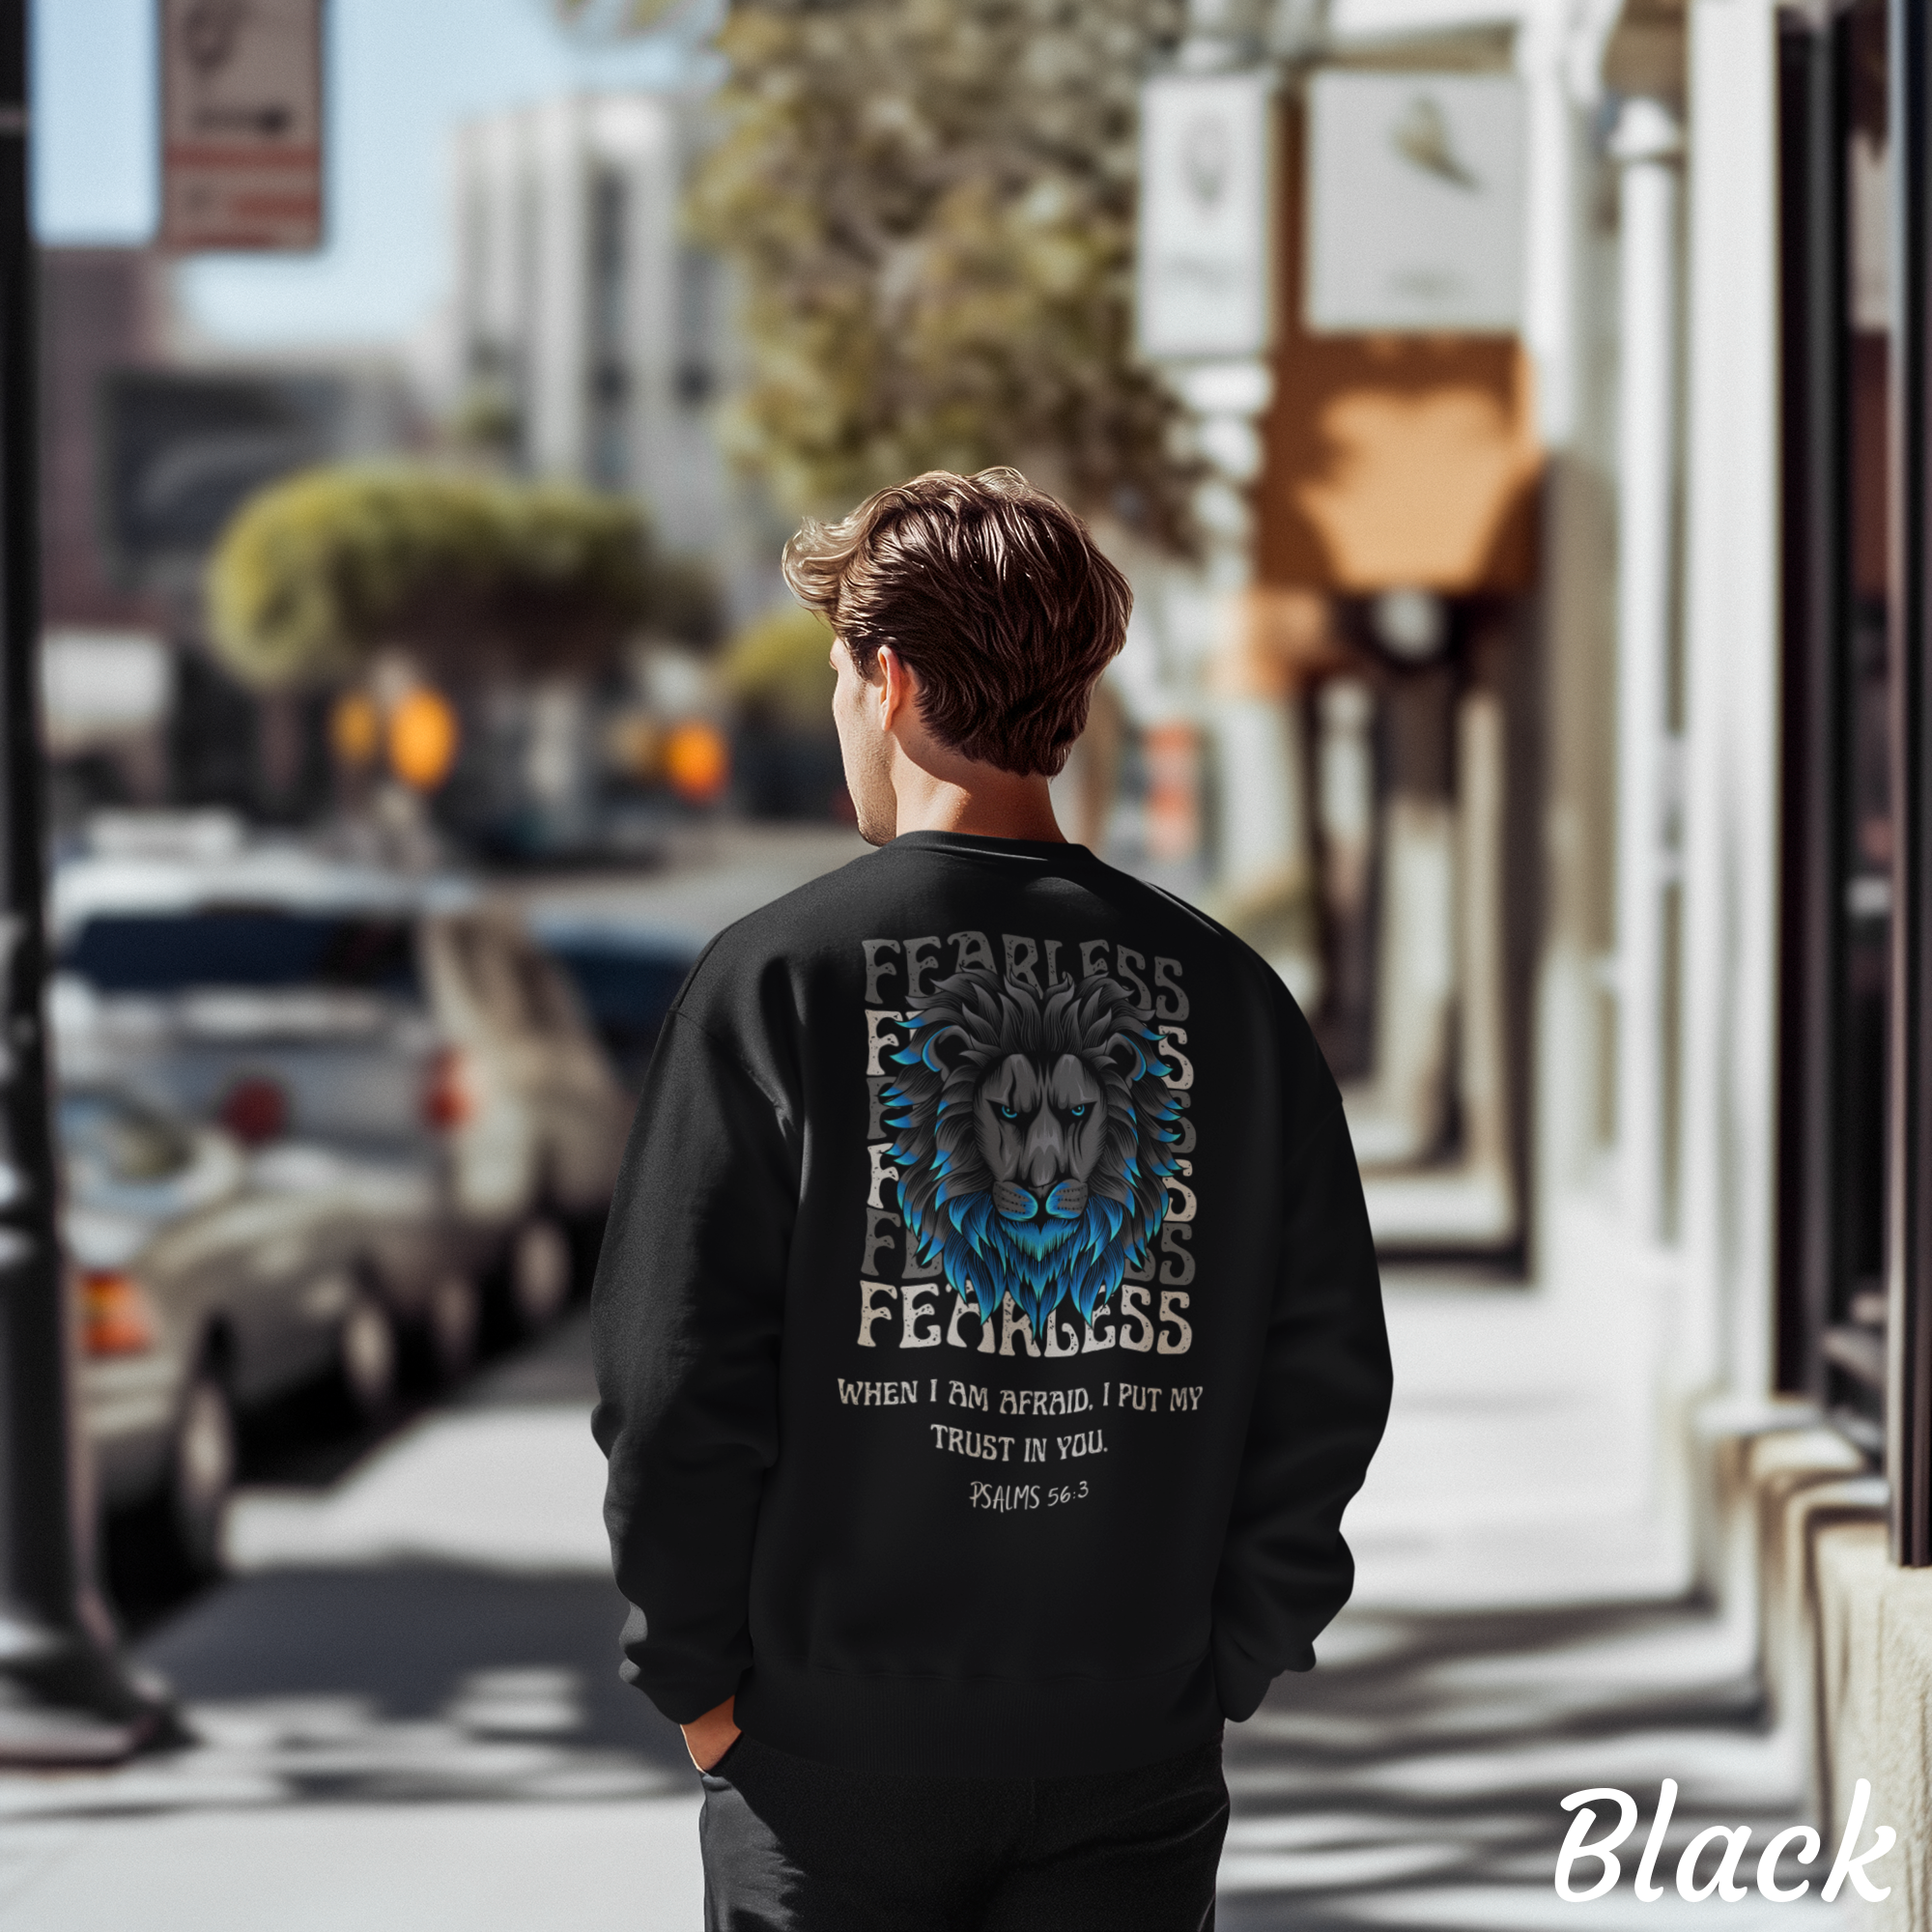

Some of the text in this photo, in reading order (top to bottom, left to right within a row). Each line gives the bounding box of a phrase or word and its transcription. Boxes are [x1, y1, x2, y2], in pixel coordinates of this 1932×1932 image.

[838, 1378, 919, 1406] WHEN
[929, 1378, 938, 1403] I
[949, 1379, 989, 1412] AM
[1102, 1381, 1111, 1406] I
[1118, 1382, 1163, 1412] PUT
[1169, 1385, 1204, 1412] MY
[930, 1423, 1109, 1463] TRUST IN YOU.
[969, 1480, 1091, 1513] PSALMS 56:3
